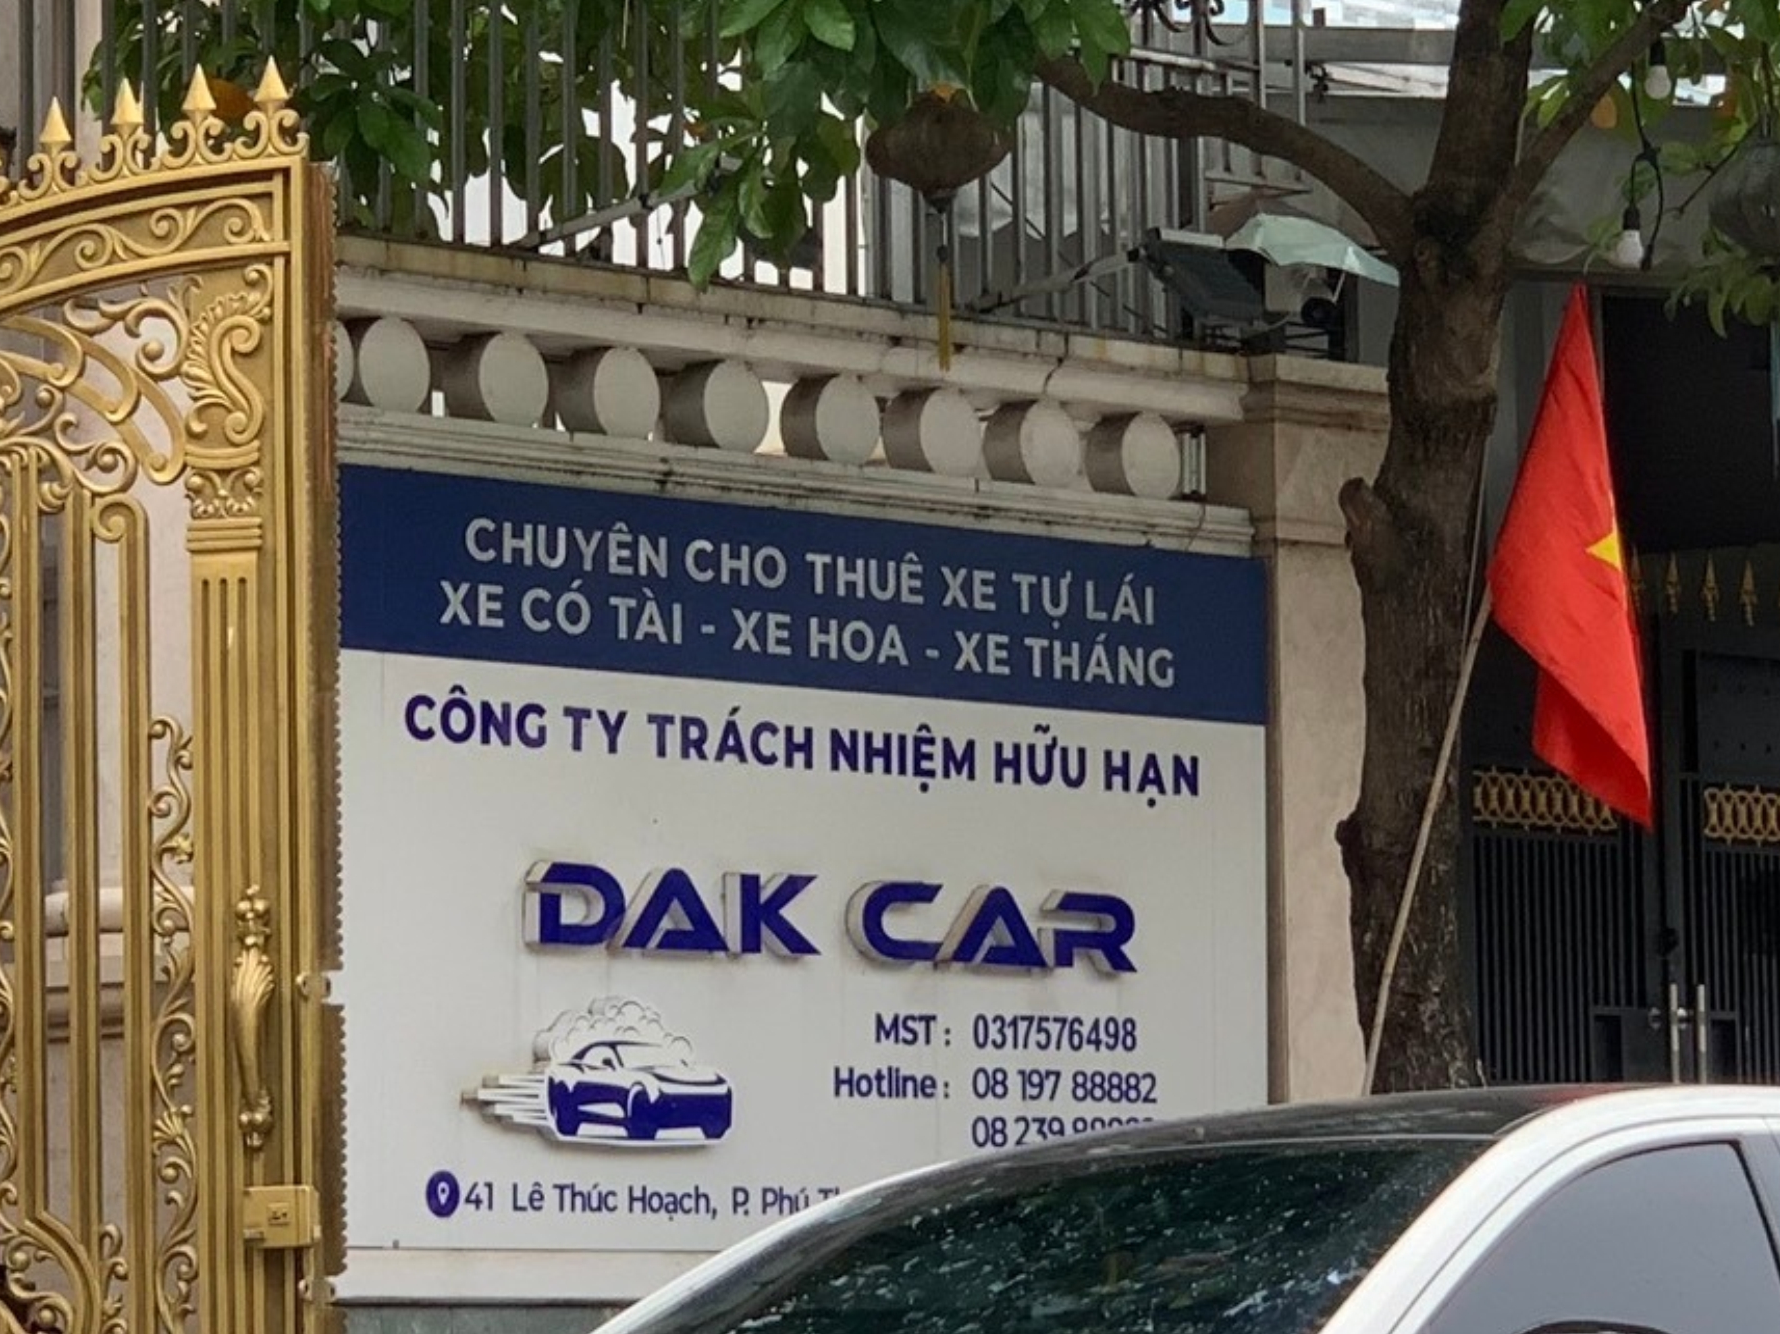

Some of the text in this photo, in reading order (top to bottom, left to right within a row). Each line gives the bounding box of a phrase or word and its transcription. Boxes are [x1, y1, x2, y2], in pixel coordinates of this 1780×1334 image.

[465, 517, 1155, 629] CHUYÊN CHO THUÊ XE TỰ LÁI
[439, 580, 505, 629] XE
[520, 579, 592, 636] CÓ
[609, 587, 684, 645] TÀI
[731, 608, 793, 656] XE
[809, 617, 909, 666] HOA
[953, 630, 1011, 676] XE
[1023, 633, 1176, 689] THÁNG
[404, 684, 1200, 809] CÔNG TY TRÁCH NHIỆM HỮU HẠN
[523, 859, 1139, 976] DAK CAR
[972, 1013, 1138, 1052] 0317576498
[971, 1067, 1009, 1100] 08
[1017, 1068, 1061, 1102] 197
[1071, 1070, 1158, 1104] 88882
[971, 1115, 1009, 1148] 08
[464, 1181, 494, 1212] 41
[511, 1182, 545, 1212] Lê
[553, 1180, 618, 1213] Thúc
[628, 1184, 718, 1222] Hoạch,
[732, 1186, 750, 1216] P.
[761, 1186, 810, 1215] Phú
